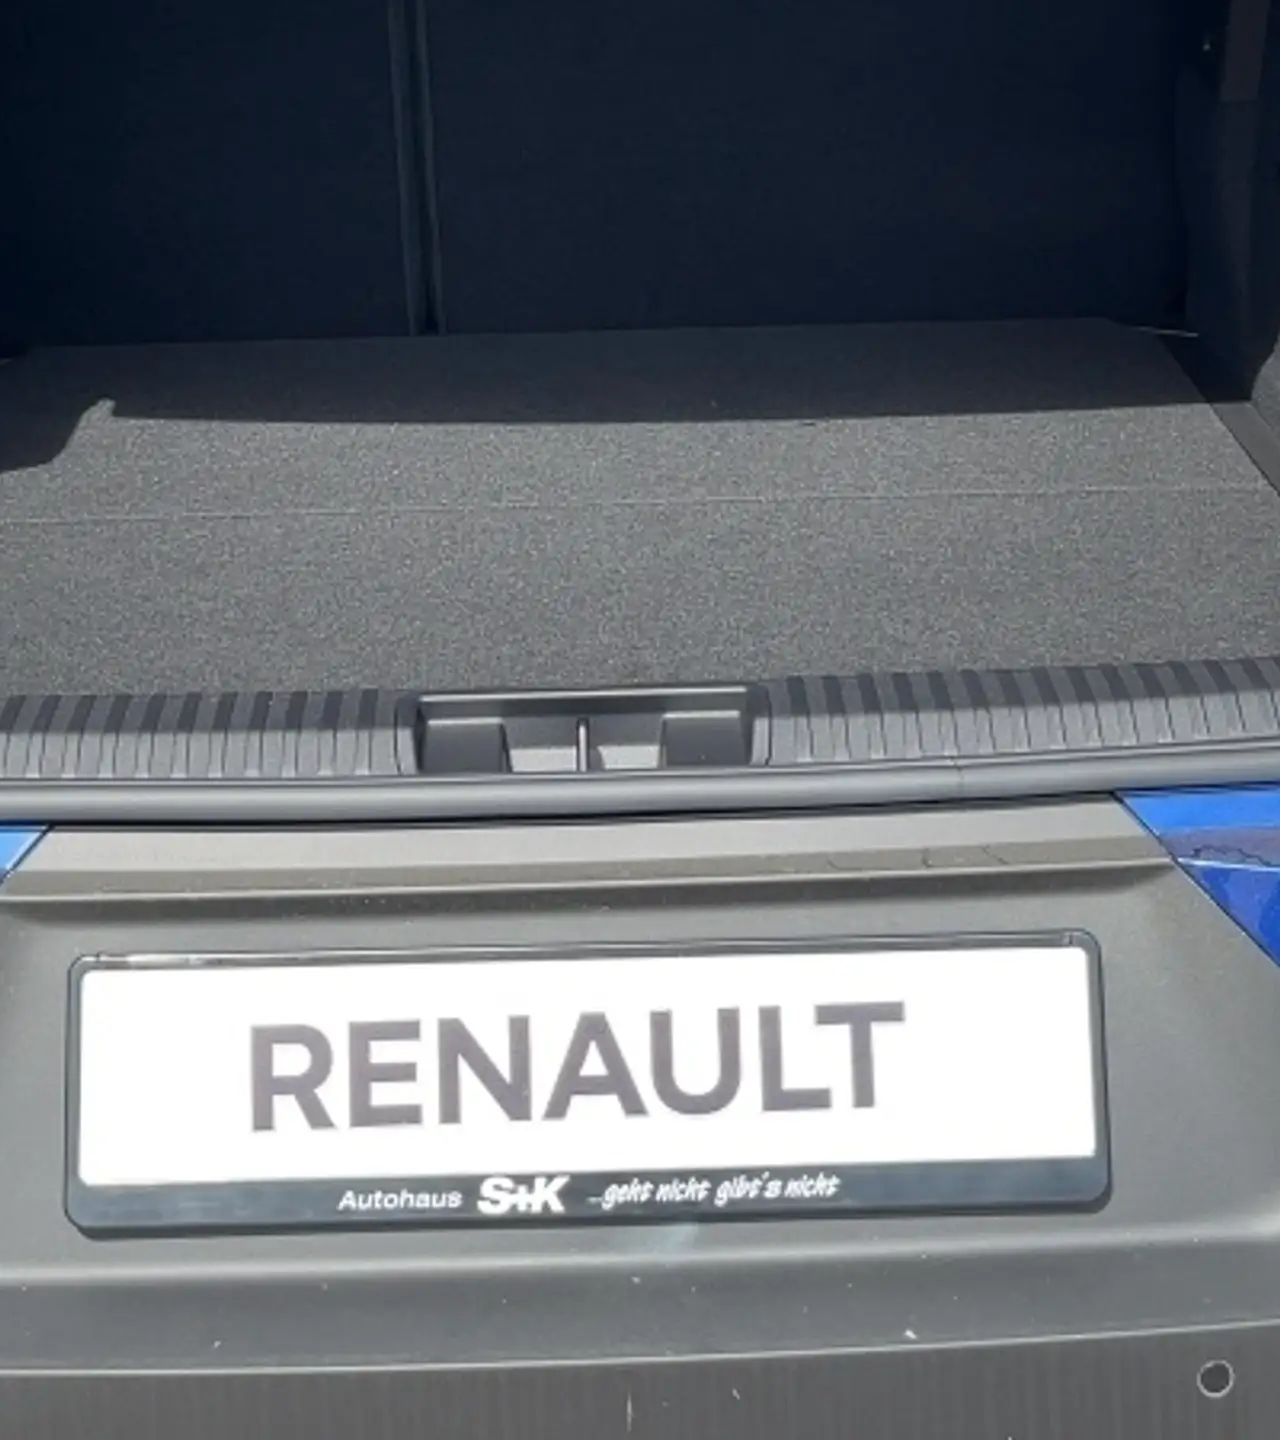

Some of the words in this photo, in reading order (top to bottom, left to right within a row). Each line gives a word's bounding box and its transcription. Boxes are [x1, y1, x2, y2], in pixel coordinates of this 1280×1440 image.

[252, 1001, 905, 1131] RENAULT
[336, 1188, 464, 1211] Autohaus
[477, 1173, 570, 1216] S+K
[655, 1176, 712, 1203] nicht
[784, 1171, 842, 1199] nicht
